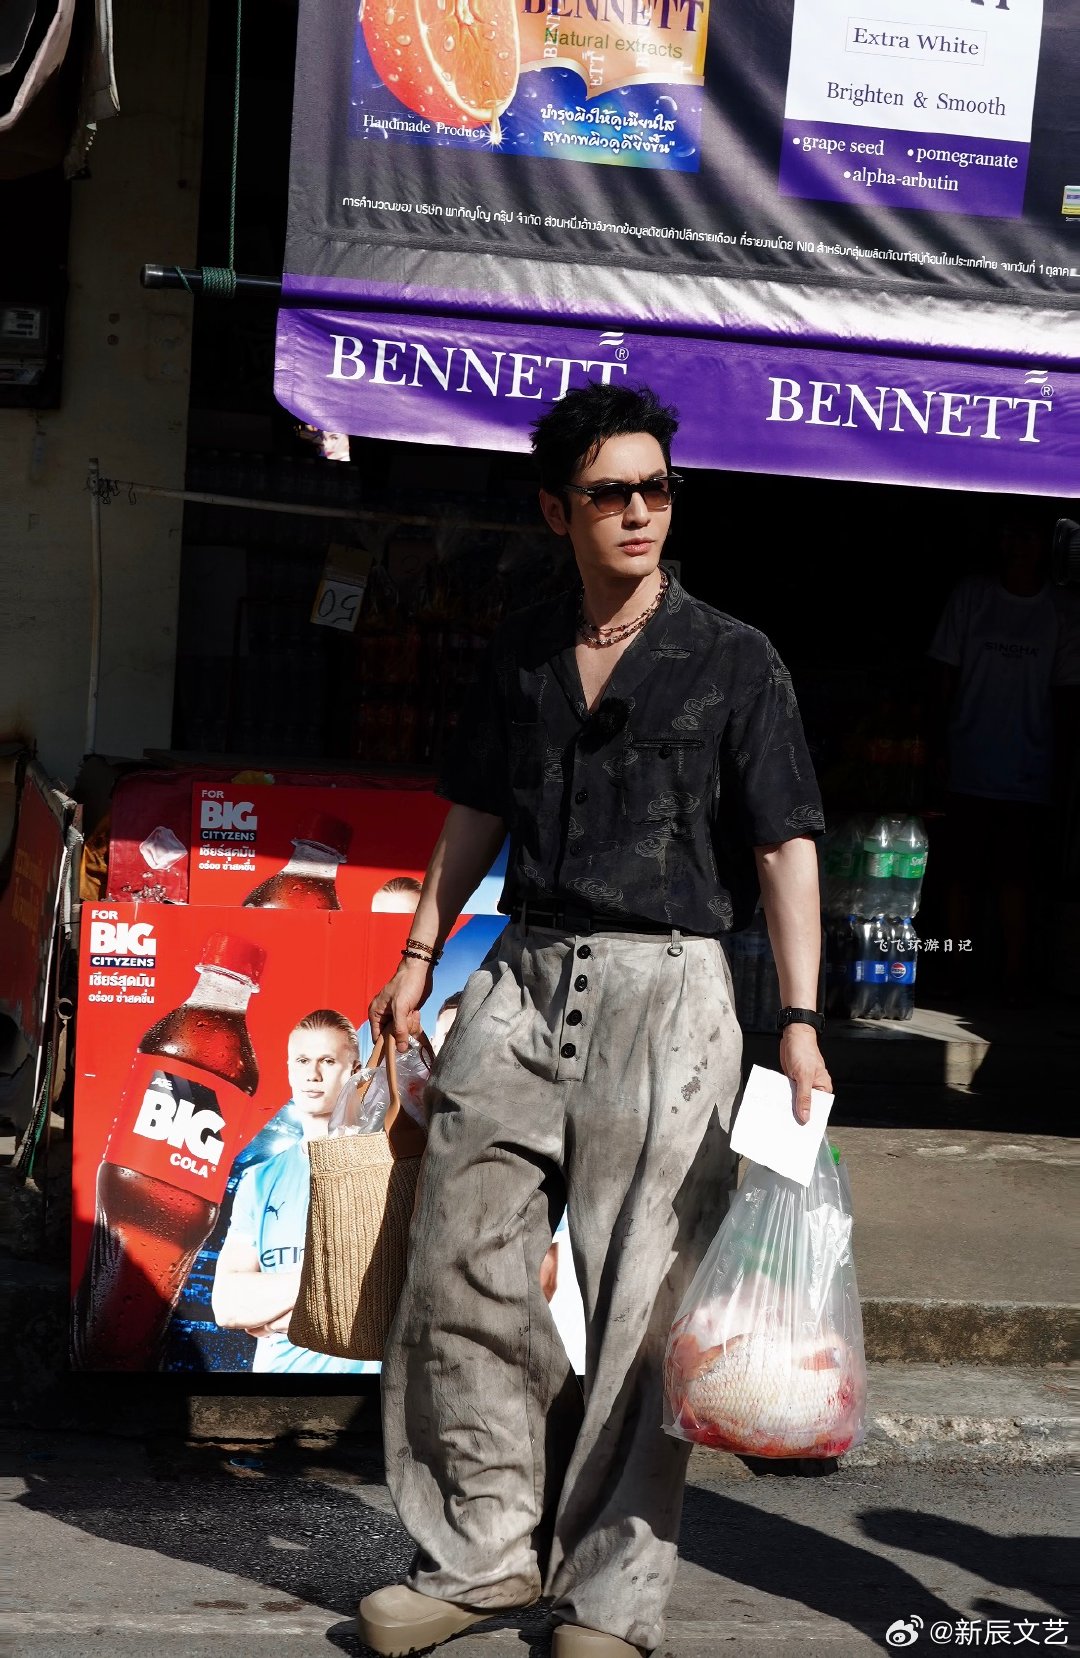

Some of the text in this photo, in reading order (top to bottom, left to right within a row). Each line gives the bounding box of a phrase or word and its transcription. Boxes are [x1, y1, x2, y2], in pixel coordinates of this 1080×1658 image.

[544, 27, 683, 59] Natural extracts
[852, 27, 979, 56] Extra White
[827, 82, 1006, 116] Brighten & Smooth
[363, 114, 486, 138] Handmade Product
[802, 136, 884, 156] grape seed
[916, 147, 1018, 169] pomegranate
[853, 167, 959, 191] alpha-arbutin
[415, 203, 443, 216] บริษัท
[493, 210, 514, 226] กรุ๊ป
[516, 212, 541, 226] จำกัด
[796, 240, 815, 253] NIQ
[1039, 264, 1044, 275] 1
[1046, 266, 1080, 278] ตุลาค
[326, 334, 627, 401] BENNETT
[765, 376, 1052, 443] BENNETT
[202, 789, 224, 799] FOR
[201, 800, 257, 830] BIG
[202, 831, 255, 841] CITYZENS
[199, 861, 220, 871] อร่อย
[91, 910, 118, 920] FOR
[90, 922, 156, 956] BIG
[92, 957, 155, 968] CITYZENS
[89, 972, 155, 992] เชียร์สุดมัน
[88, 990, 155, 1004] อร่อย ซ่าสดชื่น
[133, 1088, 227, 1166] BIG
[170, 1153, 208, 1178] COLA
